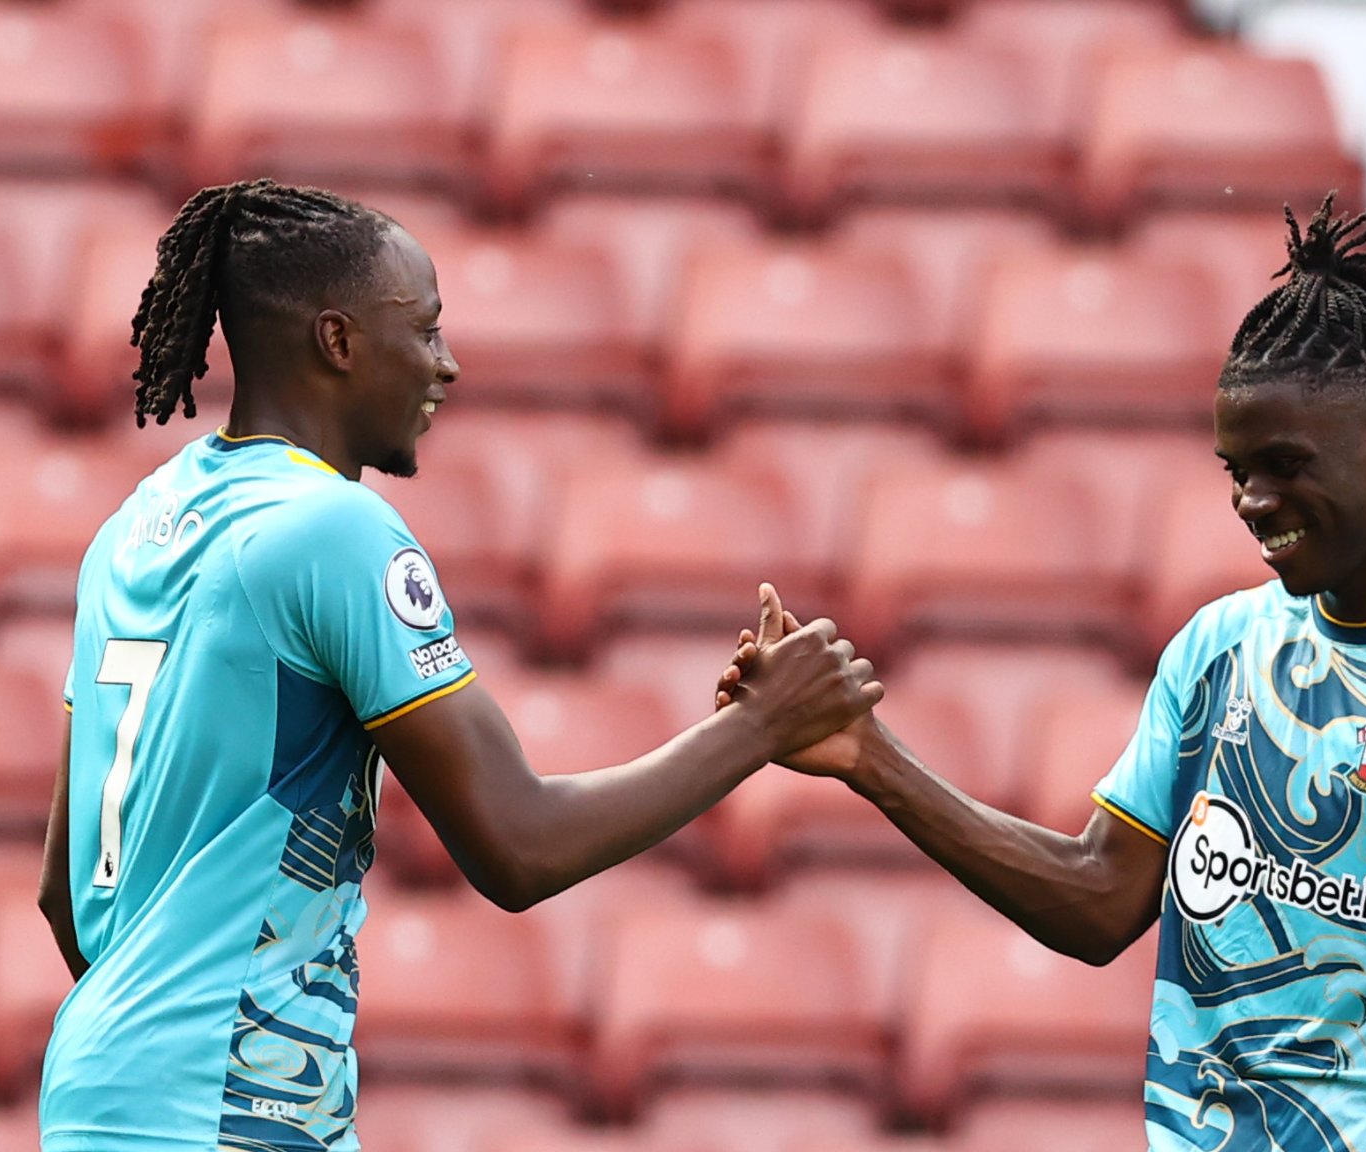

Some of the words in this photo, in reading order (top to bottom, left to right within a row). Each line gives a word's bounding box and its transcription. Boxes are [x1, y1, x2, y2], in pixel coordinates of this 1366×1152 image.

[409, 648, 431, 664] No
[1211, 722, 1247, 745] hummel
[92, 638, 169, 889] 7
